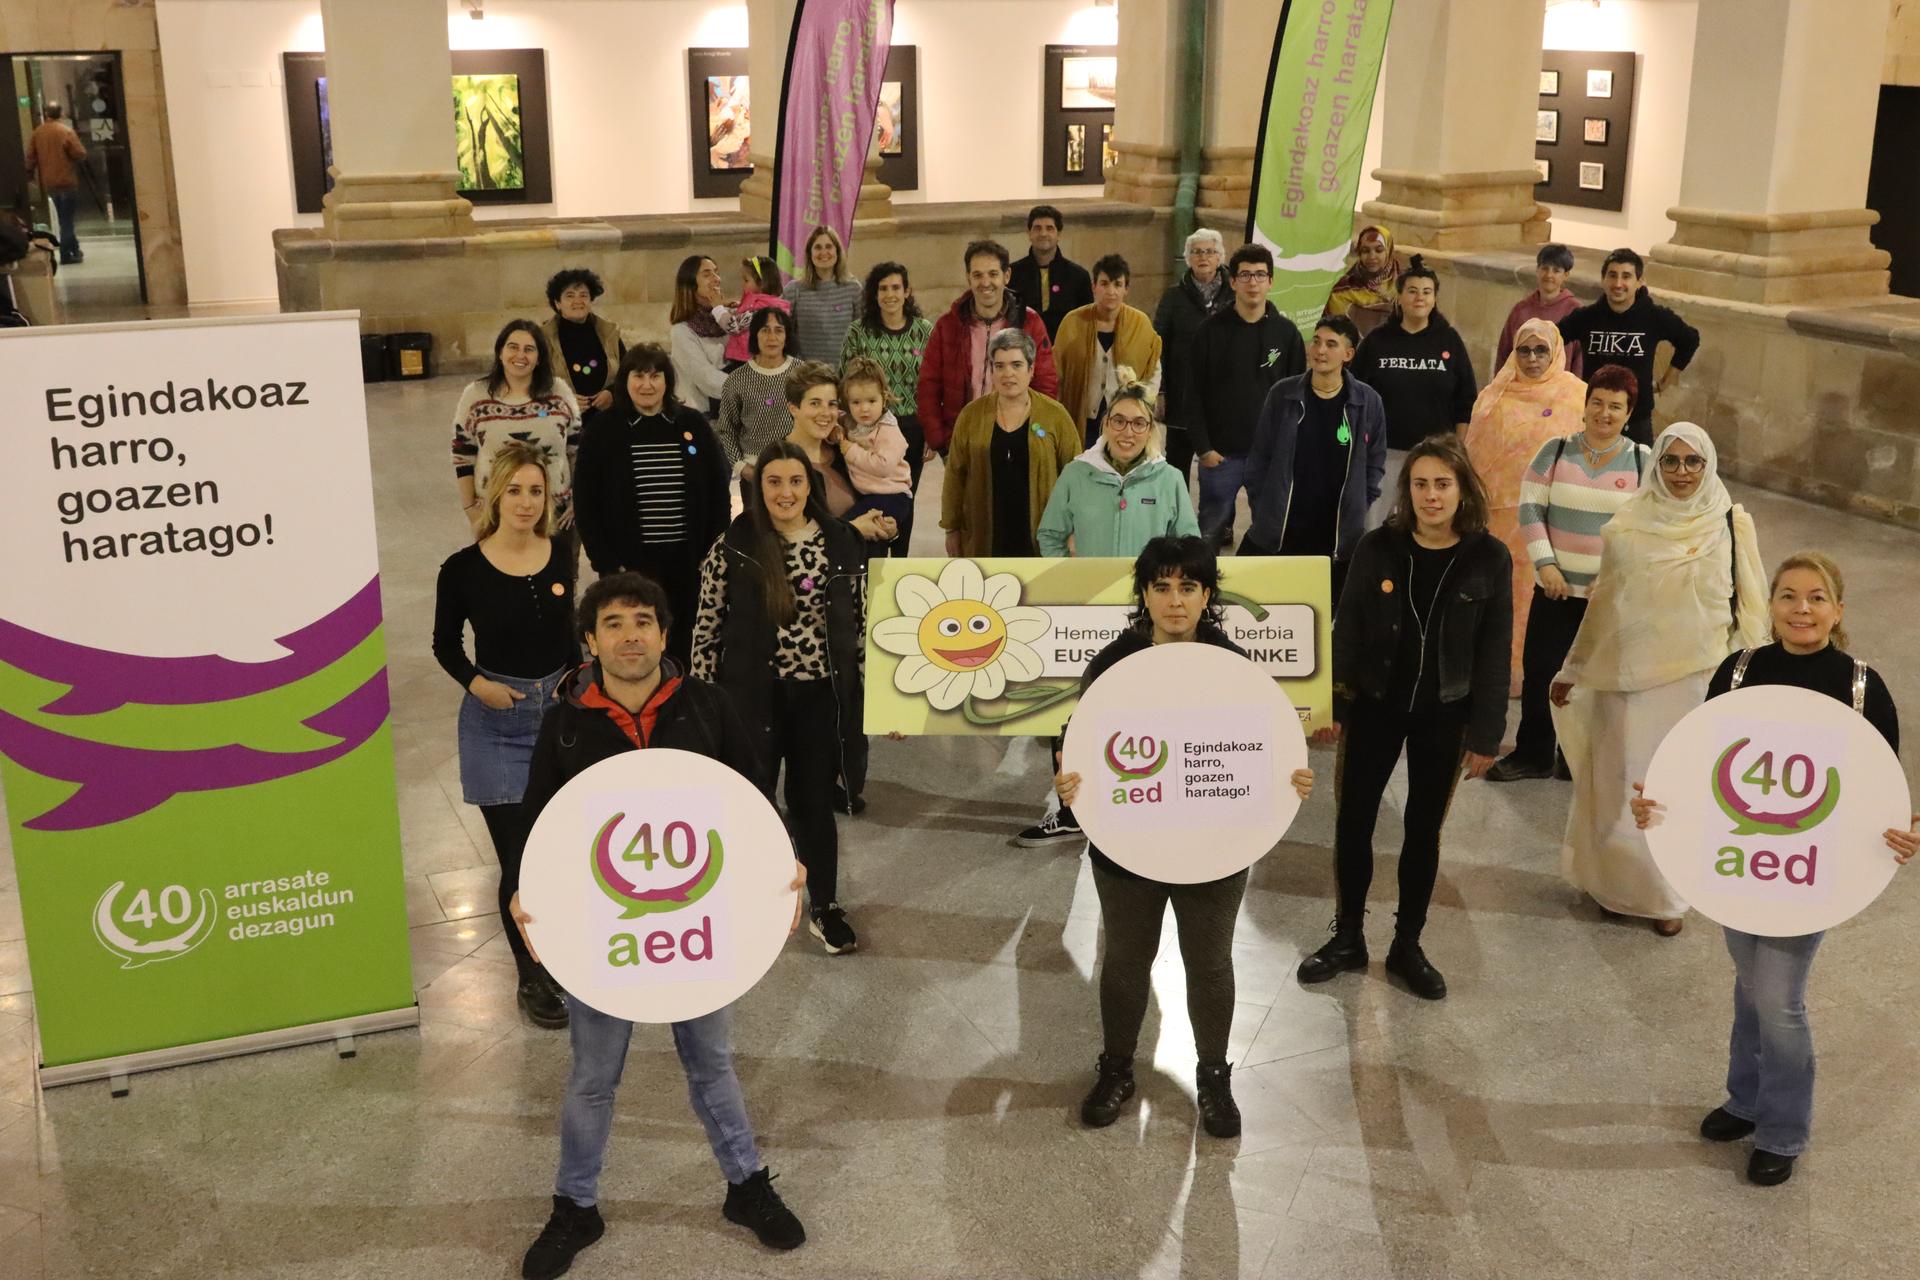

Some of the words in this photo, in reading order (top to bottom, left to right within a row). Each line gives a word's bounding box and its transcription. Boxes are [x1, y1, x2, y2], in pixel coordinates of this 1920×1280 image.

[1333, 0, 1368, 84] harata
[1281, 77, 1320, 219] Egindakoaz
[1318, 95, 1350, 193] goazen
[1588, 333, 1645, 354] HIKA
[1379, 357, 1447, 371] PERLATA
[45, 378, 310, 428] Egindakoaz
[51, 436, 186, 470] harro,
[57, 480, 219, 524] goazen
[62, 513, 274, 563] haratago!
[1055, 626, 1121, 640] Hemen
[1235, 625, 1294, 640] berbia
[1055, 648, 1102, 662] EUS
[1247, 648, 1298, 662] INKE
[1119, 735, 1156, 760] 40
[1184, 741, 1263, 755] Egindakoaz
[1184, 757, 1225, 769] harro,
[1185, 772, 1234, 786] goazen
[1741, 751, 1815, 798] 40
[1112, 781, 1162, 804] aed
[1185, 785, 1250, 799] haratago!
[622, 821, 696, 871] 40
[1714, 845, 1817, 886] aed
[224, 869, 329, 899] arrasate
[122, 885, 192, 928] 40
[226, 887, 354, 920] euskaldun
[228, 912, 335, 941] dezagun
[607, 915, 713, 967] aed
